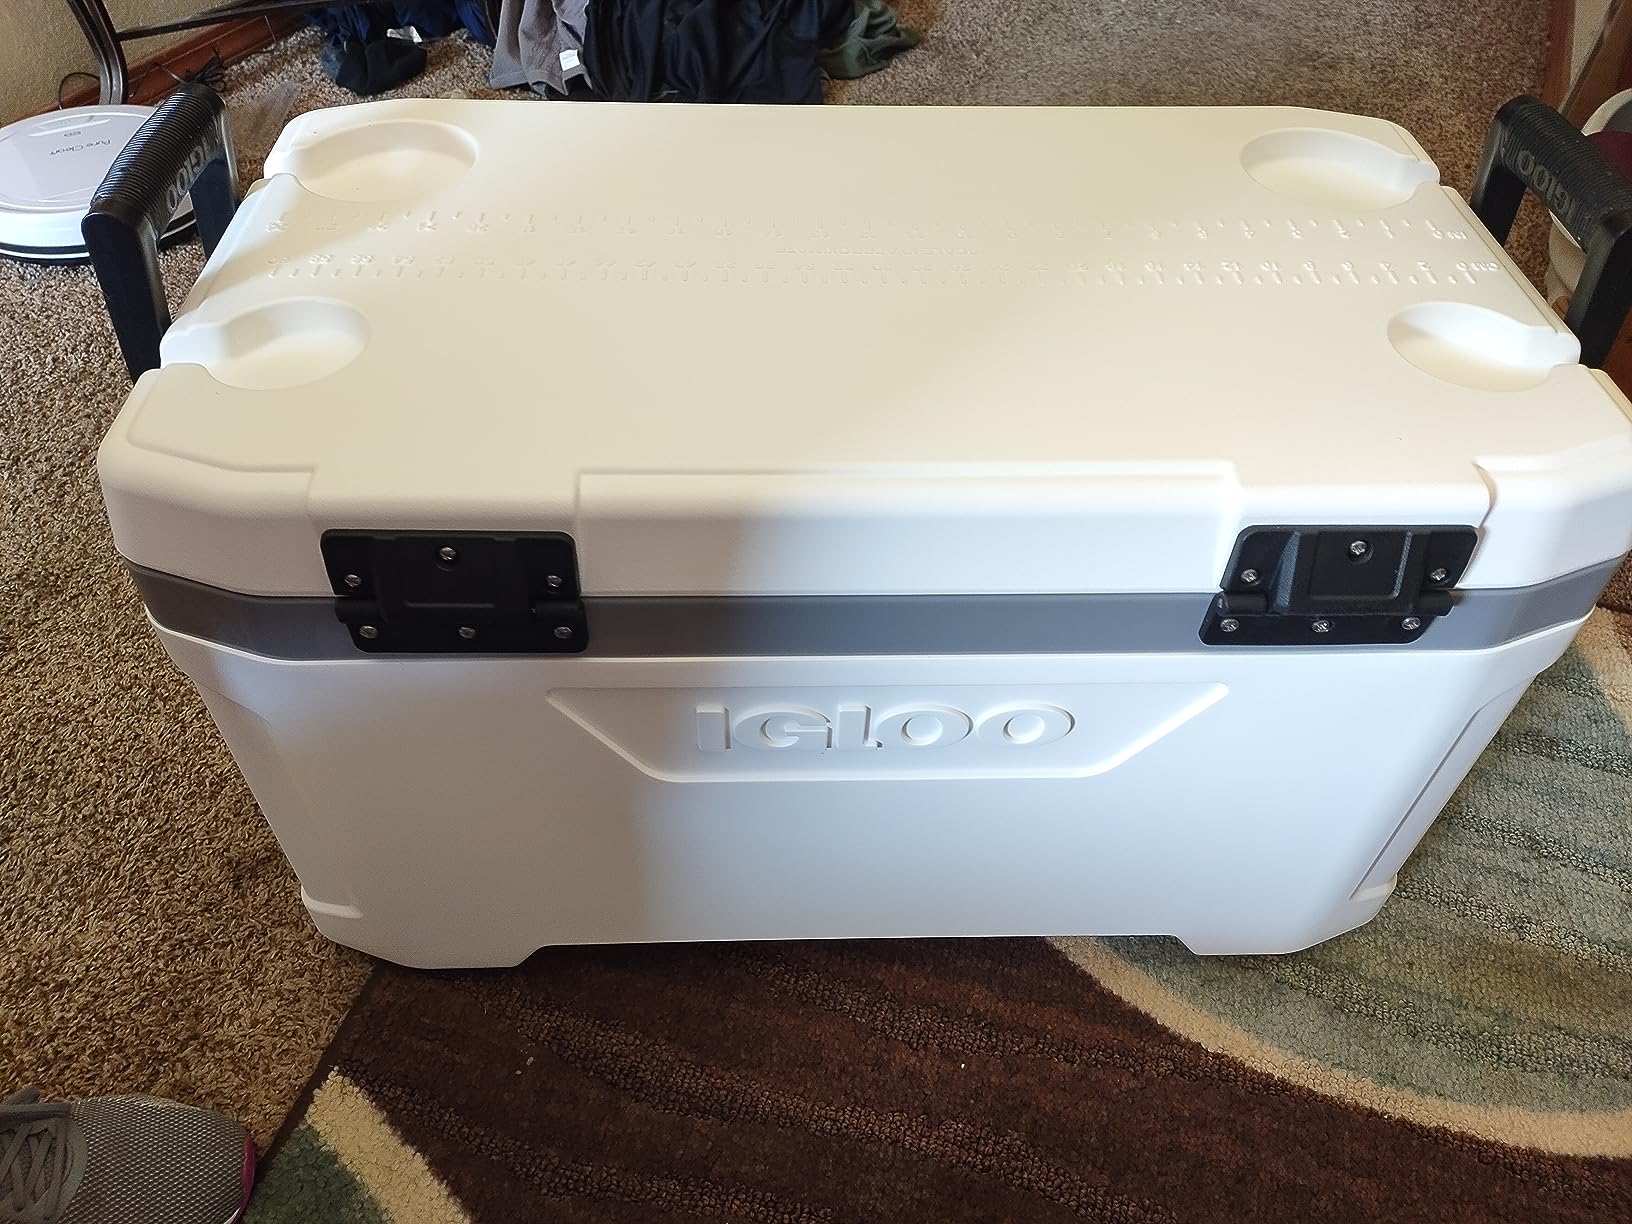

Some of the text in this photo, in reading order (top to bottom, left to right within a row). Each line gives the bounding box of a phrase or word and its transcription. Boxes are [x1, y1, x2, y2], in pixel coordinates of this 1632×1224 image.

[86, 139, 111, 148] Pure
[1416, 261, 1432, 272] 2
[1455, 261, 1468, 272] 0
[1471, 261, 1500, 272] CM
[695, 701, 1077, 751] IGLOO
